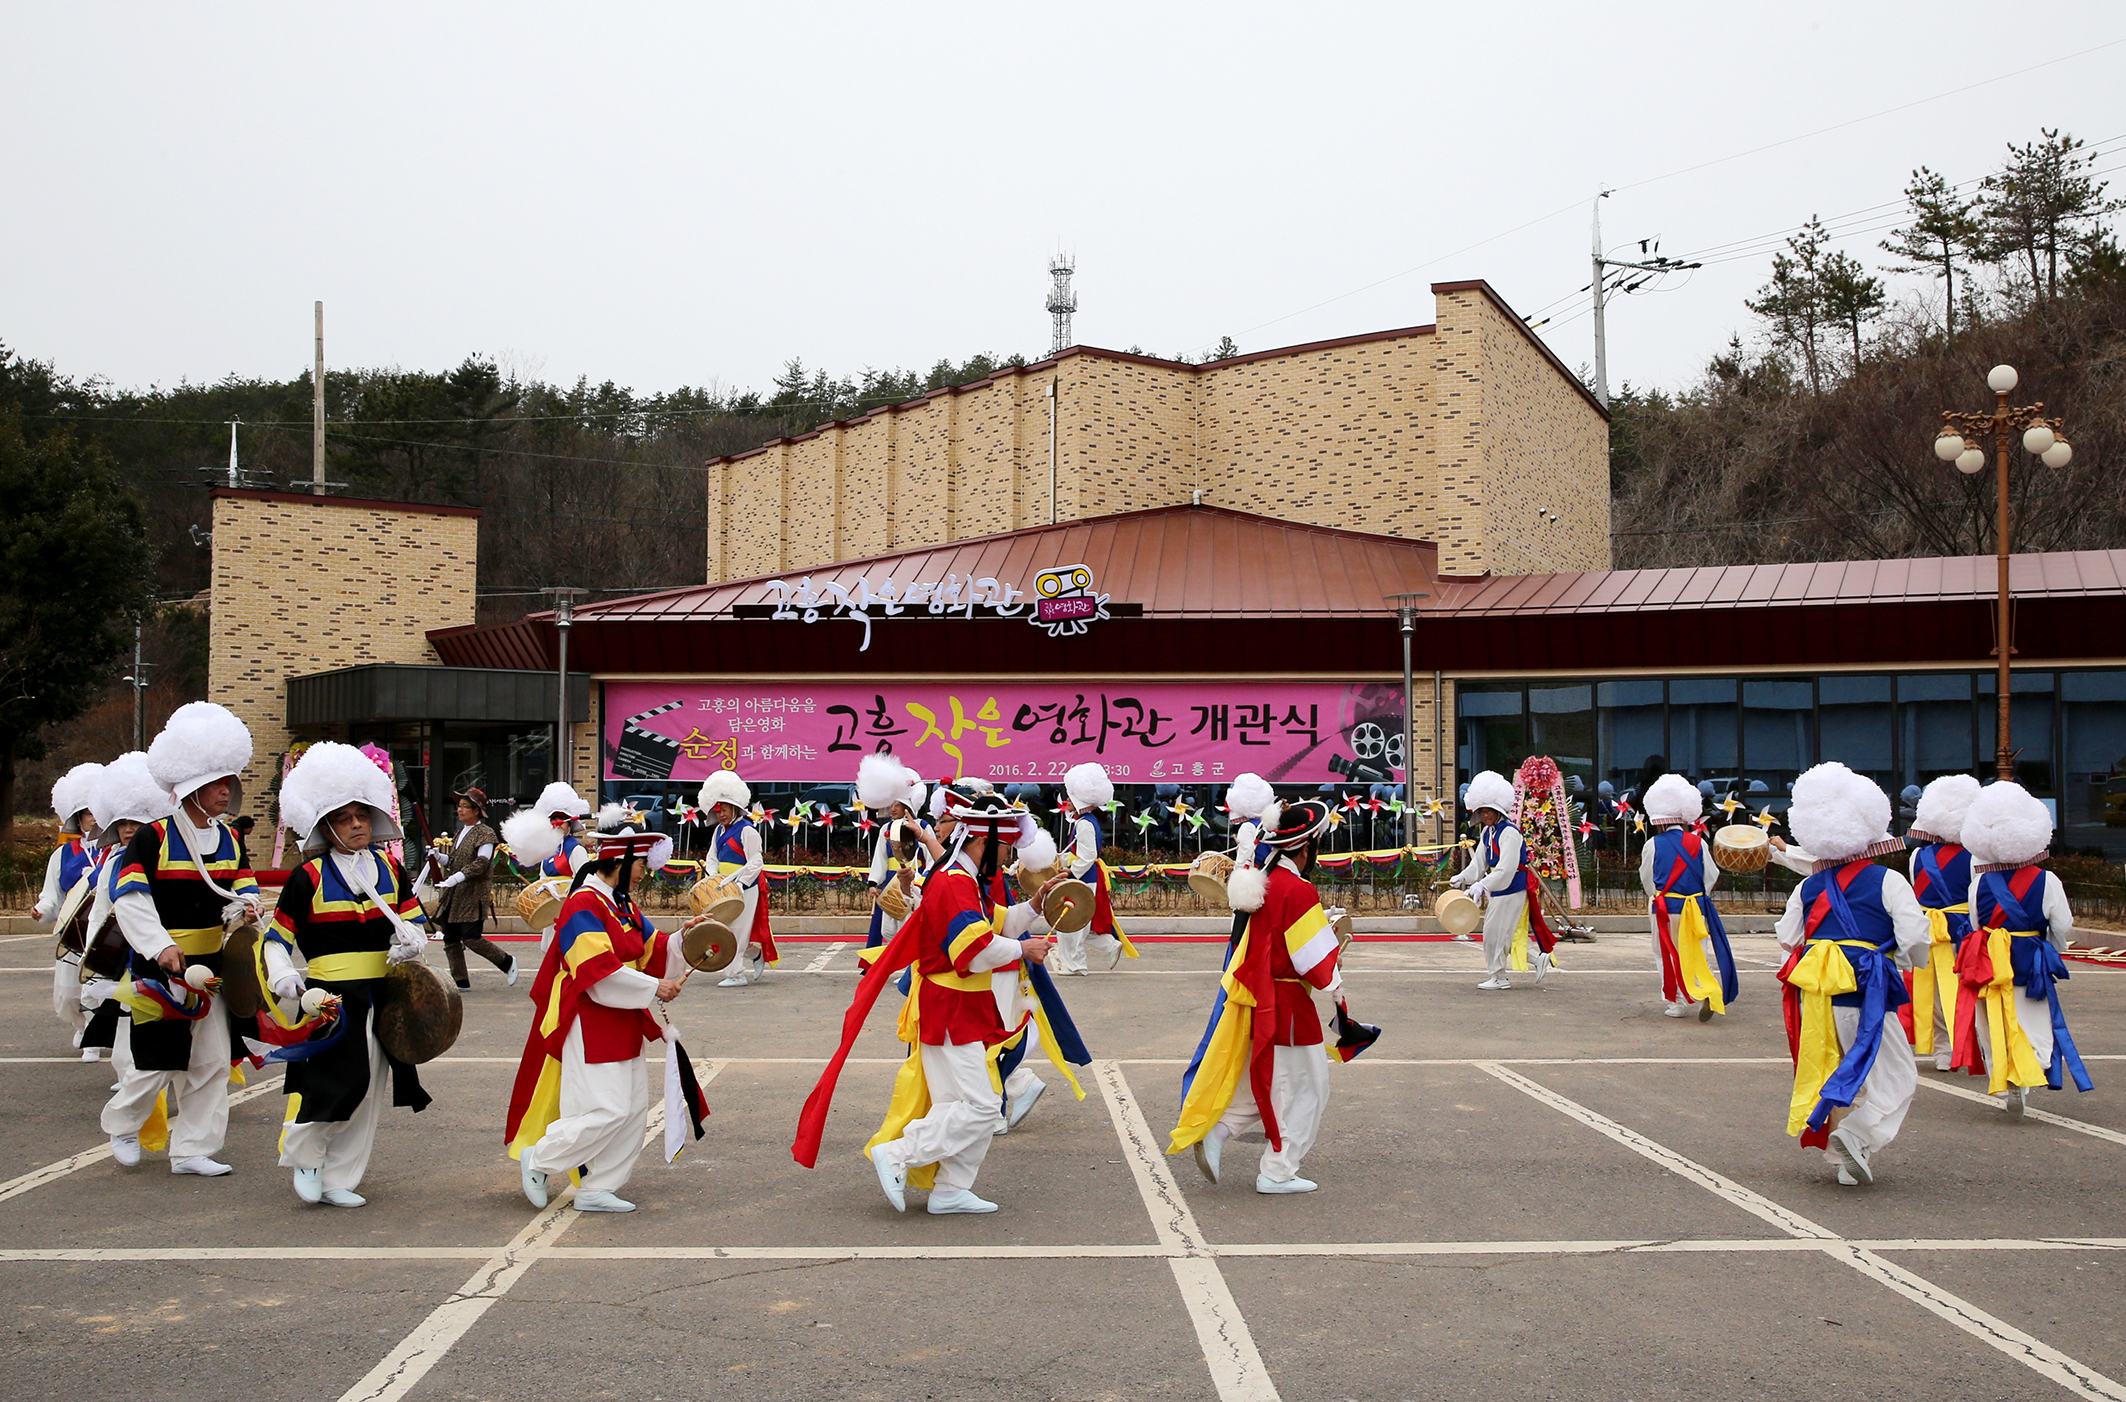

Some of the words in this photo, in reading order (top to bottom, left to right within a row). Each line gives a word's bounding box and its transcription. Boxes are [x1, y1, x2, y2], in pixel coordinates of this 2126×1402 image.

[765, 576, 828, 624] 고흥
[826, 576, 904, 652] 작은
[904, 574, 1024, 619] 영화관
[698, 698, 739, 714] 고흥의
[744, 697, 817, 713] 아름다움을
[728, 716, 787, 733] 담은영화
[826, 694, 909, 756] 고흥
[905, 695, 1012, 779] 작은
[1012, 693, 1176, 755] 영화관
[1190, 702, 1318, 747] 개관식
[679, 726, 739, 772] 순정
[760, 744, 818, 760] 함께하는
[989, 764, 1024, 776] 2016.
[1027, 761, 1043, 776] 2.
[1104, 764, 1130, 776] 3:30
